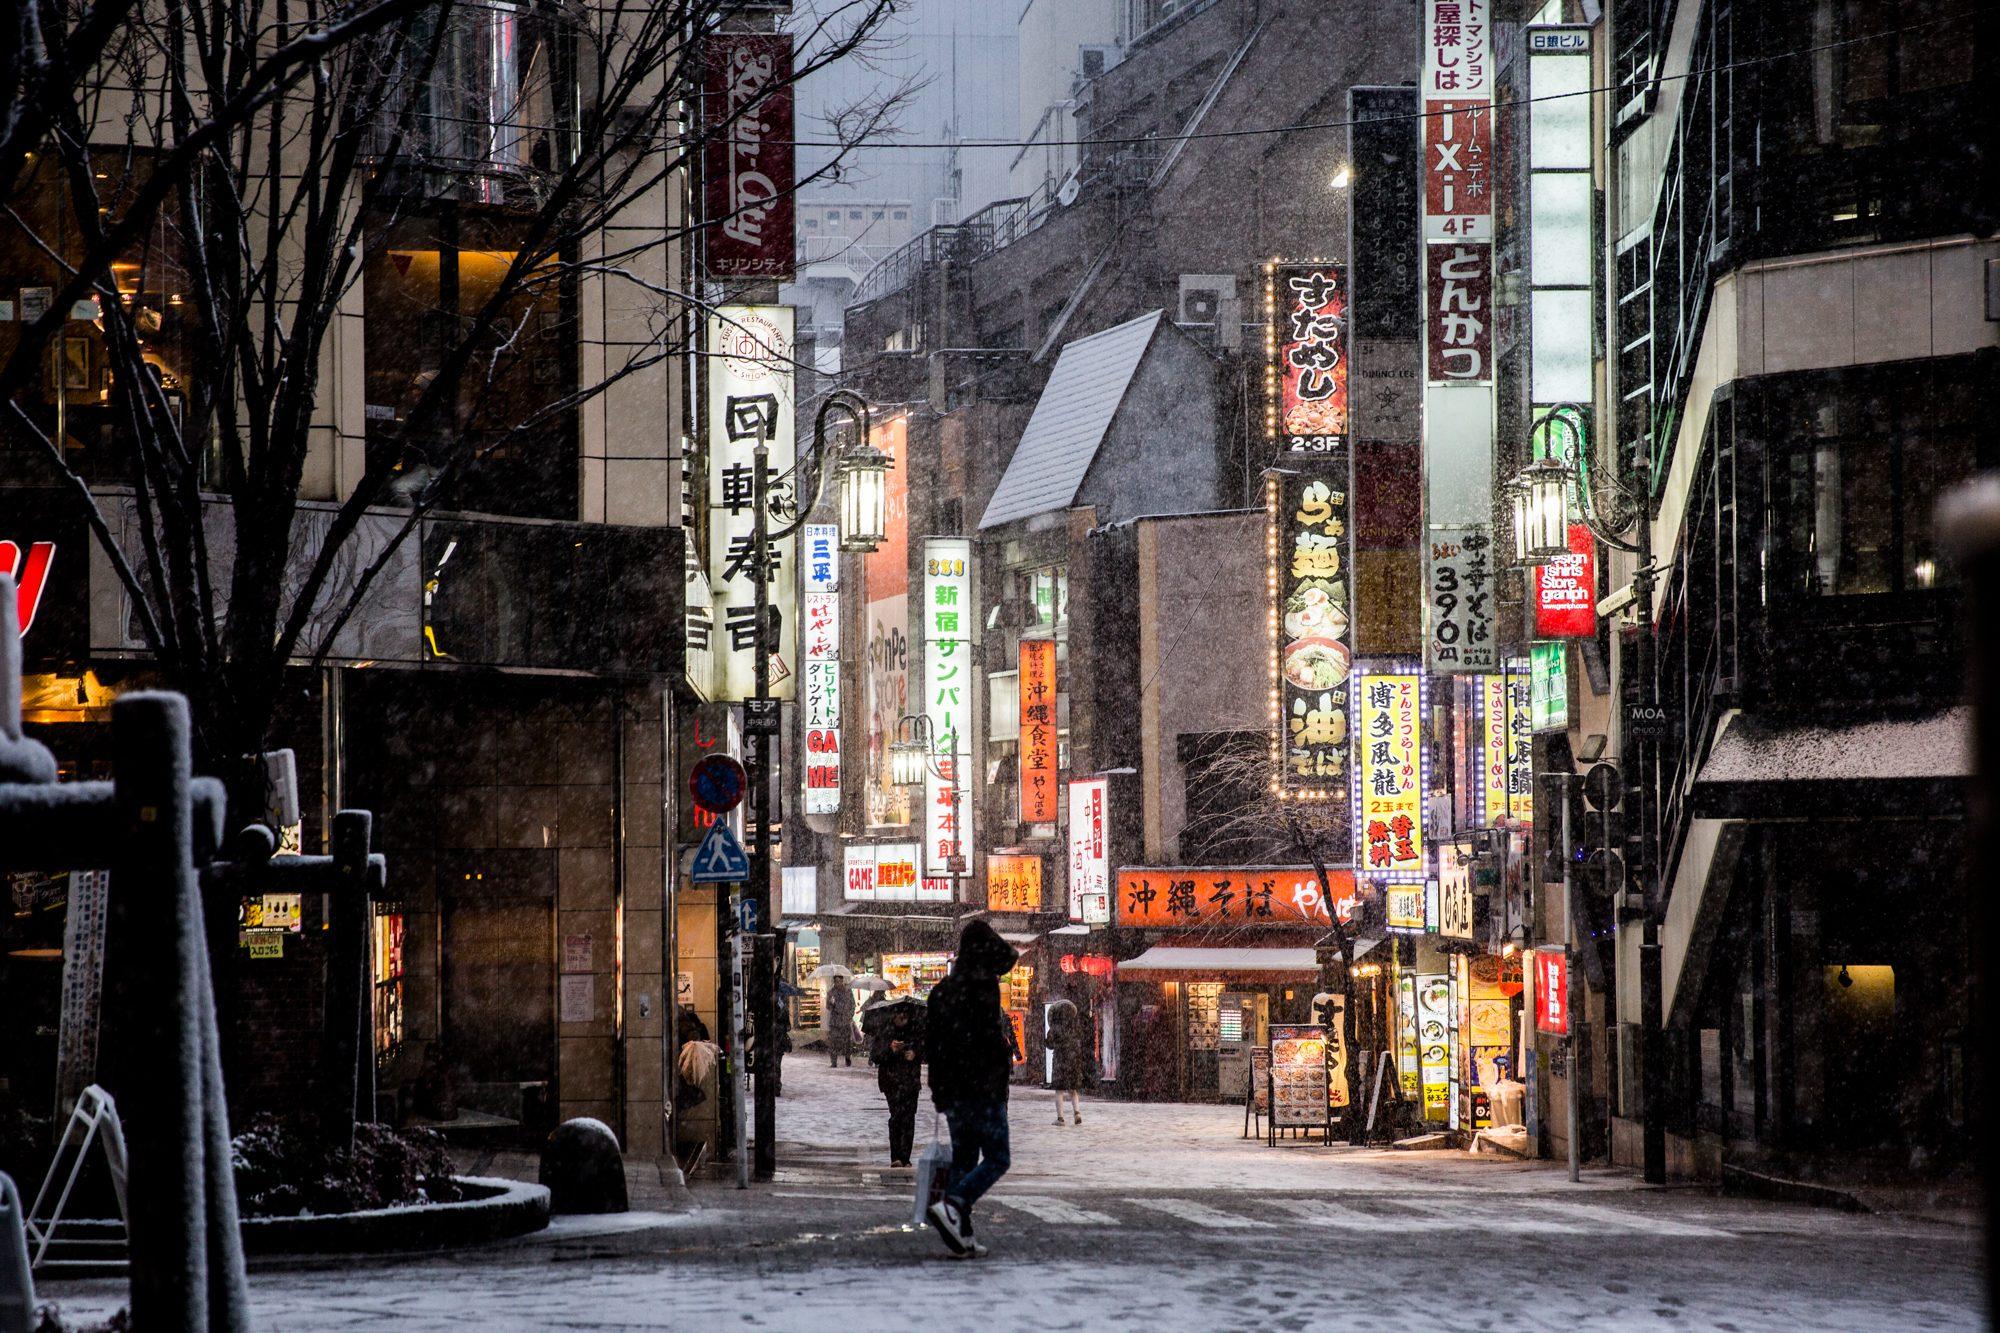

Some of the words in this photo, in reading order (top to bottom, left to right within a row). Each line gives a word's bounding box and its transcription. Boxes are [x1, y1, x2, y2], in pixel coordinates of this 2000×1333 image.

[1433, 0, 1462, 91] 屋探しは
[1534, 34, 1585, 48] 日銀ビル
[1466, 104, 1485, 198] ルーム・デポ
[1442, 217, 1476, 236] 4F
[716, 257, 787, 271] キリンシティ
[1439, 247, 1484, 378] とんかつ
[741, 315, 783, 342] RESTAURANT
[806, 526, 837, 537] 日本料理
[812, 539, 832, 583] 三平
[1431, 542, 1462, 561] うまい
[1551, 553, 1588, 569] esign
[1461, 531, 1493, 645] 中華そば
[1541, 576, 1577, 589] Store
[1541, 587, 1589, 603] graniph
[806, 595, 838, 604] レストラン
[1434, 566, 1461, 663] 390円
[935, 584, 960, 754] 新宿サンパーク
[808, 663, 823, 726] ダーツゲーム
[824, 663, 837, 719] ビリヤード
[748, 699, 776, 713] モア
[1631, 707, 1666, 720] MOA
[1026, 681, 1050, 770] 沖縄食堂
[1367, 681, 1402, 797] 博多風龍
[1400, 682, 1414, 790] とんこつらーめん
[1370, 801, 1415, 813] 2玉まで
[1365, 819, 1394, 868] 無料
[1389, 814, 1420, 863] 替玉
[848, 867, 874, 891] GAME
[989, 877, 1030, 906] 沖縄食堂
[1127, 879, 1276, 919] 沖縄そば
[1426, 1093, 1449, 1102] 替玉2
